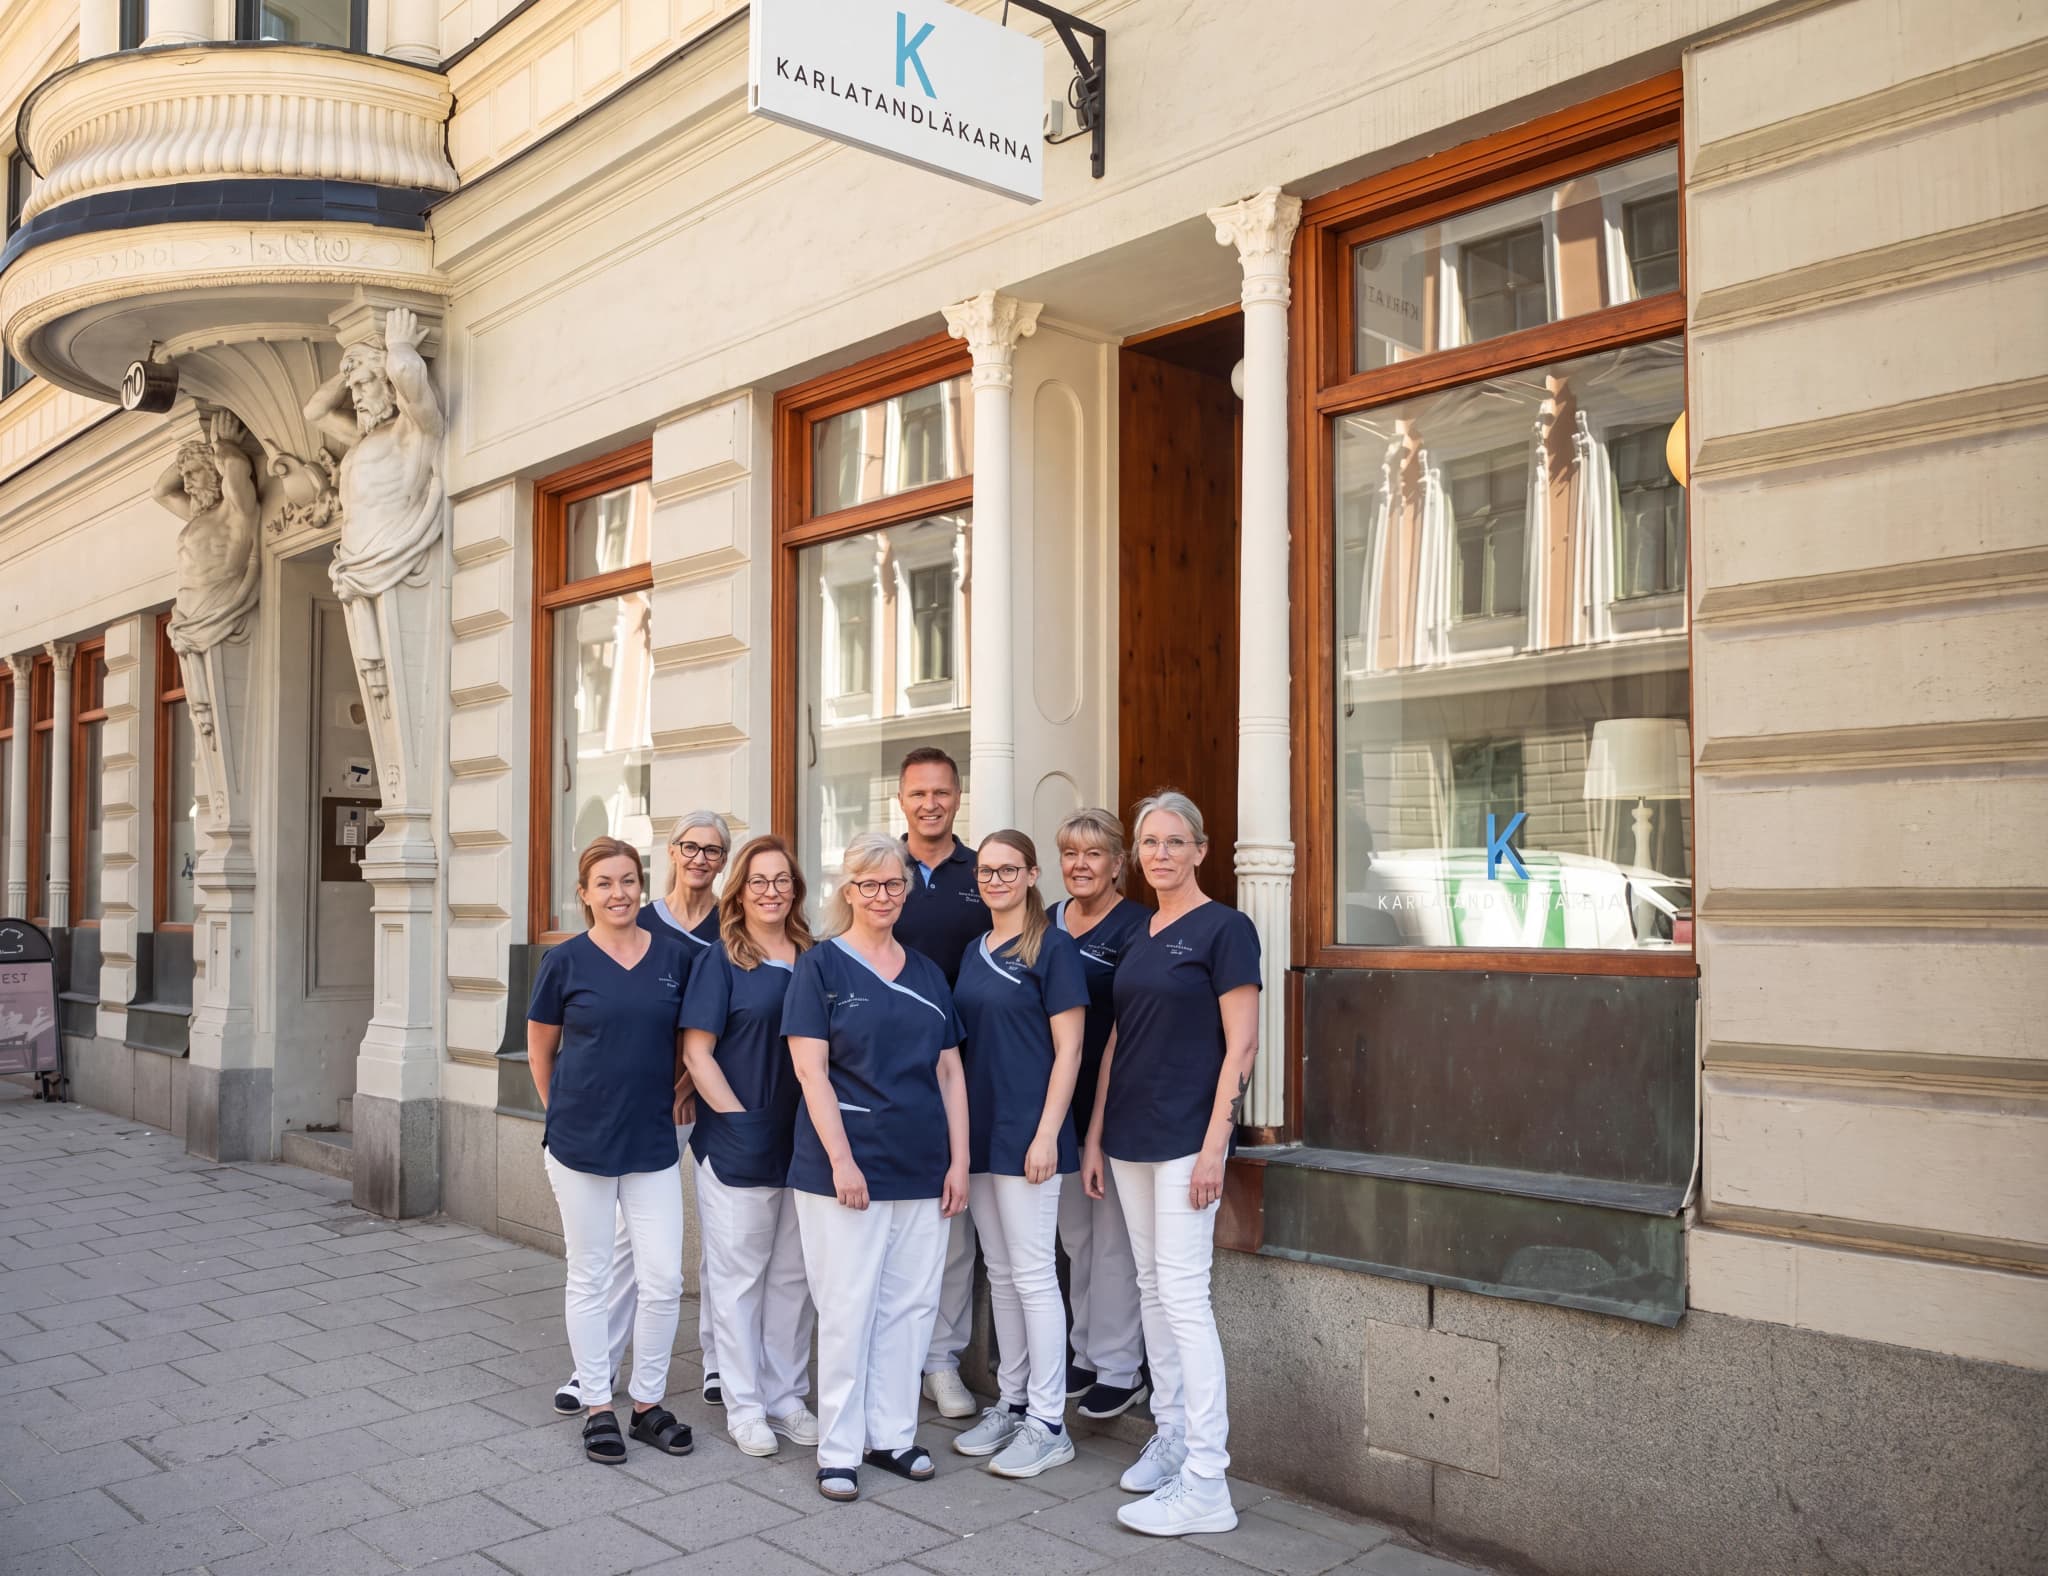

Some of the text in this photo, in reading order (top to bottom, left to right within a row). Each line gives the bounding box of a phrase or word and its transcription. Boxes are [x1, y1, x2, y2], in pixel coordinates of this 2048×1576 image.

[896, 11, 937, 100] K
[776, 56, 1033, 163] KARLATANDLÄKARNA
[1487, 812, 1530, 880] K
